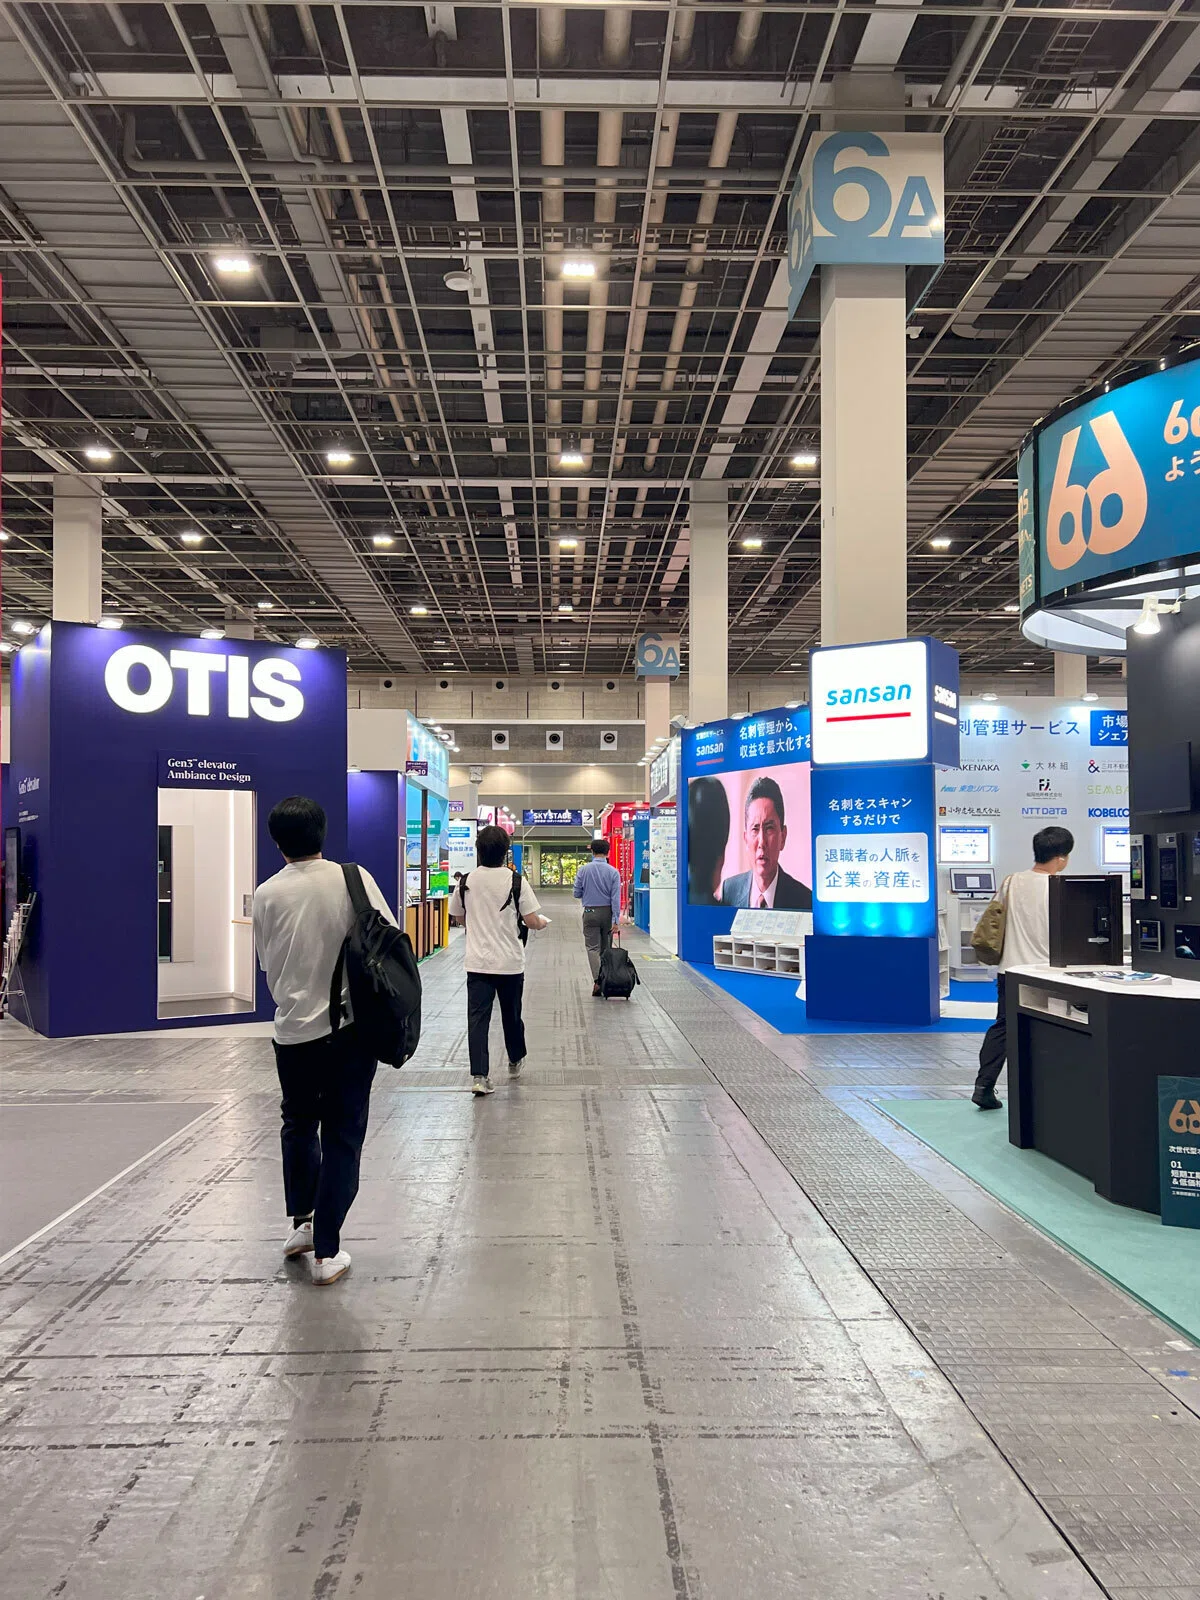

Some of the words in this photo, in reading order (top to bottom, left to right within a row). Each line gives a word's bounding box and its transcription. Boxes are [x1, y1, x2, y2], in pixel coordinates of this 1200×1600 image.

[812, 131, 938, 239] 6A
[638, 632, 680, 668] 6A
[104, 644, 305, 723] OTIS
[826, 684, 912, 706] sansan
[739, 717, 798, 741] 名刺管理から、
[696, 742, 724, 757] sansan
[198, 760, 237, 770] elevator
[167, 770, 217, 780] Ambiance
[219, 772, 251, 783] Design
[828, 798, 912, 811] 名刺をスキャン
[1021, 807, 1041, 815] NTT
[840, 814, 902, 826] するだけで
[1088, 807, 1129, 818] KOBELCO
[825, 847, 920, 863] 退職者の人脈を
[825, 870, 921, 888] 企業の資産に
[1170, 1160, 1182, 1169] 01
